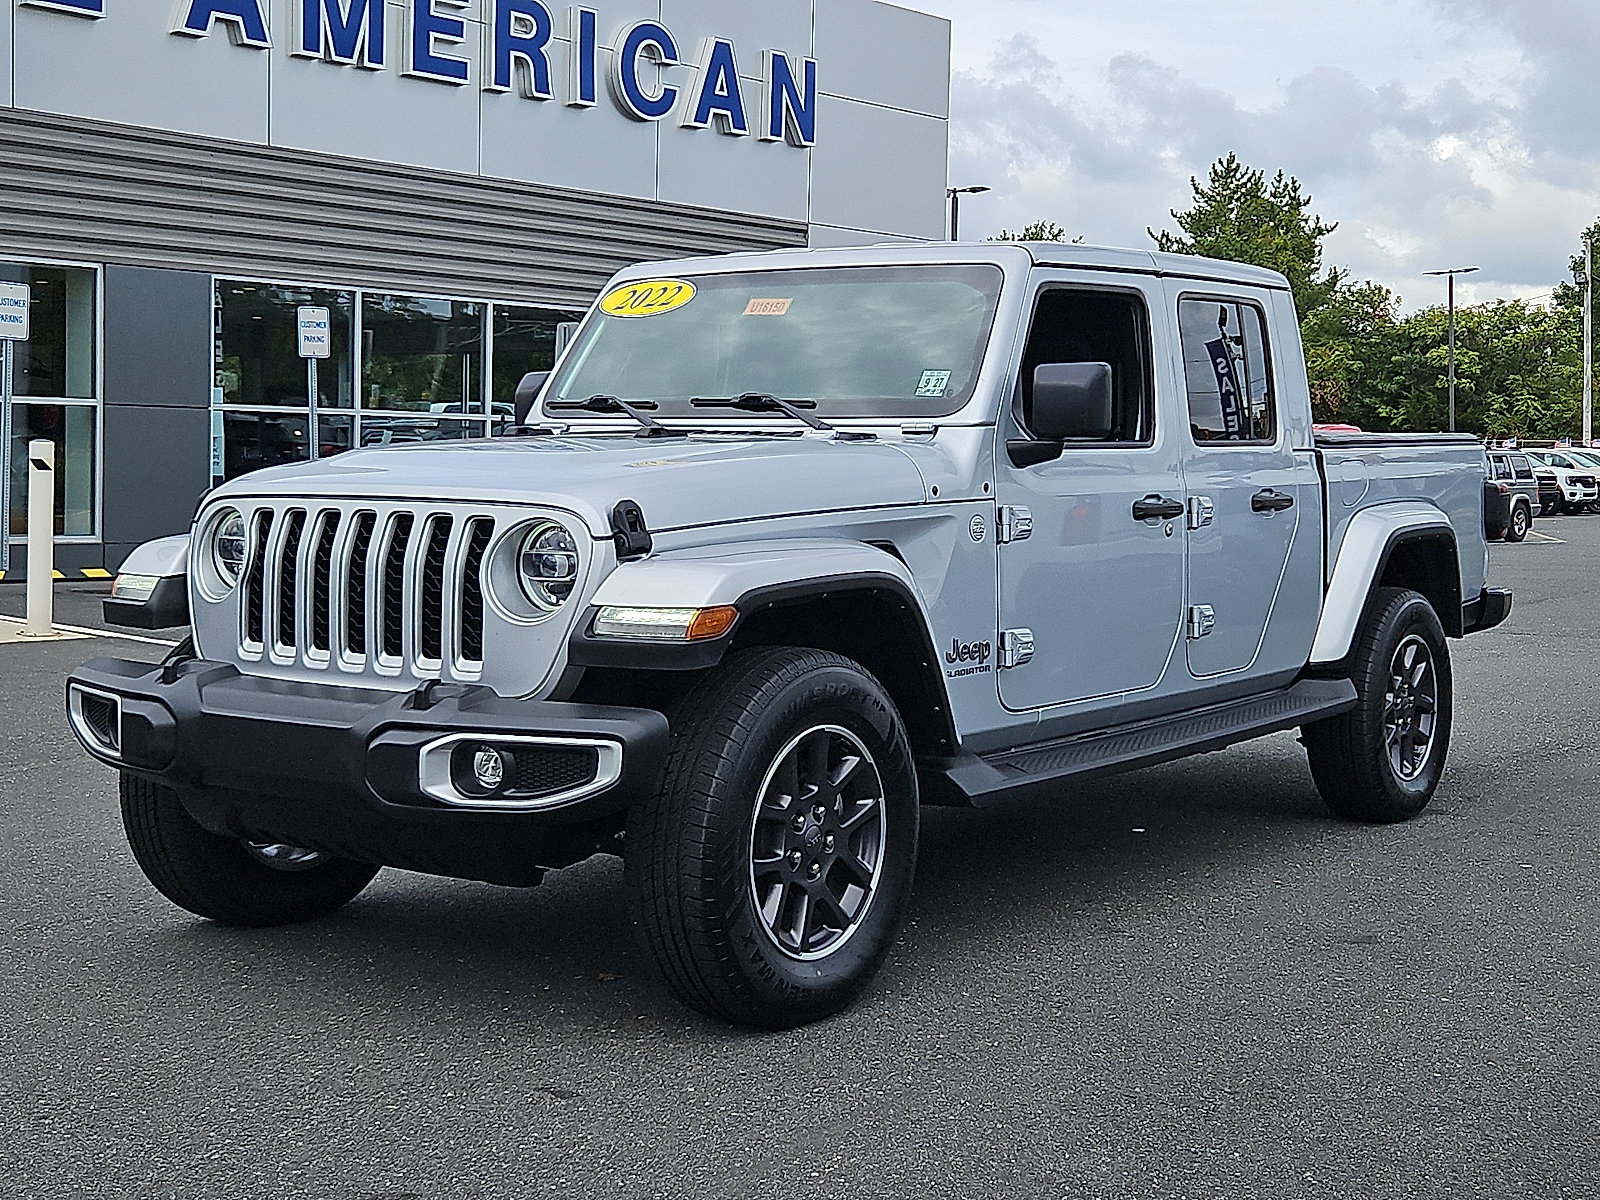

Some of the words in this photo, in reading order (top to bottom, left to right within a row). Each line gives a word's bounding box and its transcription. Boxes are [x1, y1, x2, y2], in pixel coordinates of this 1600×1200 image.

[0, 297, 27, 307] USTOMER
[612, 285, 683, 310] 2022
[750, 301, 786, 313] U16150
[945, 637, 990, 664] Jeep
